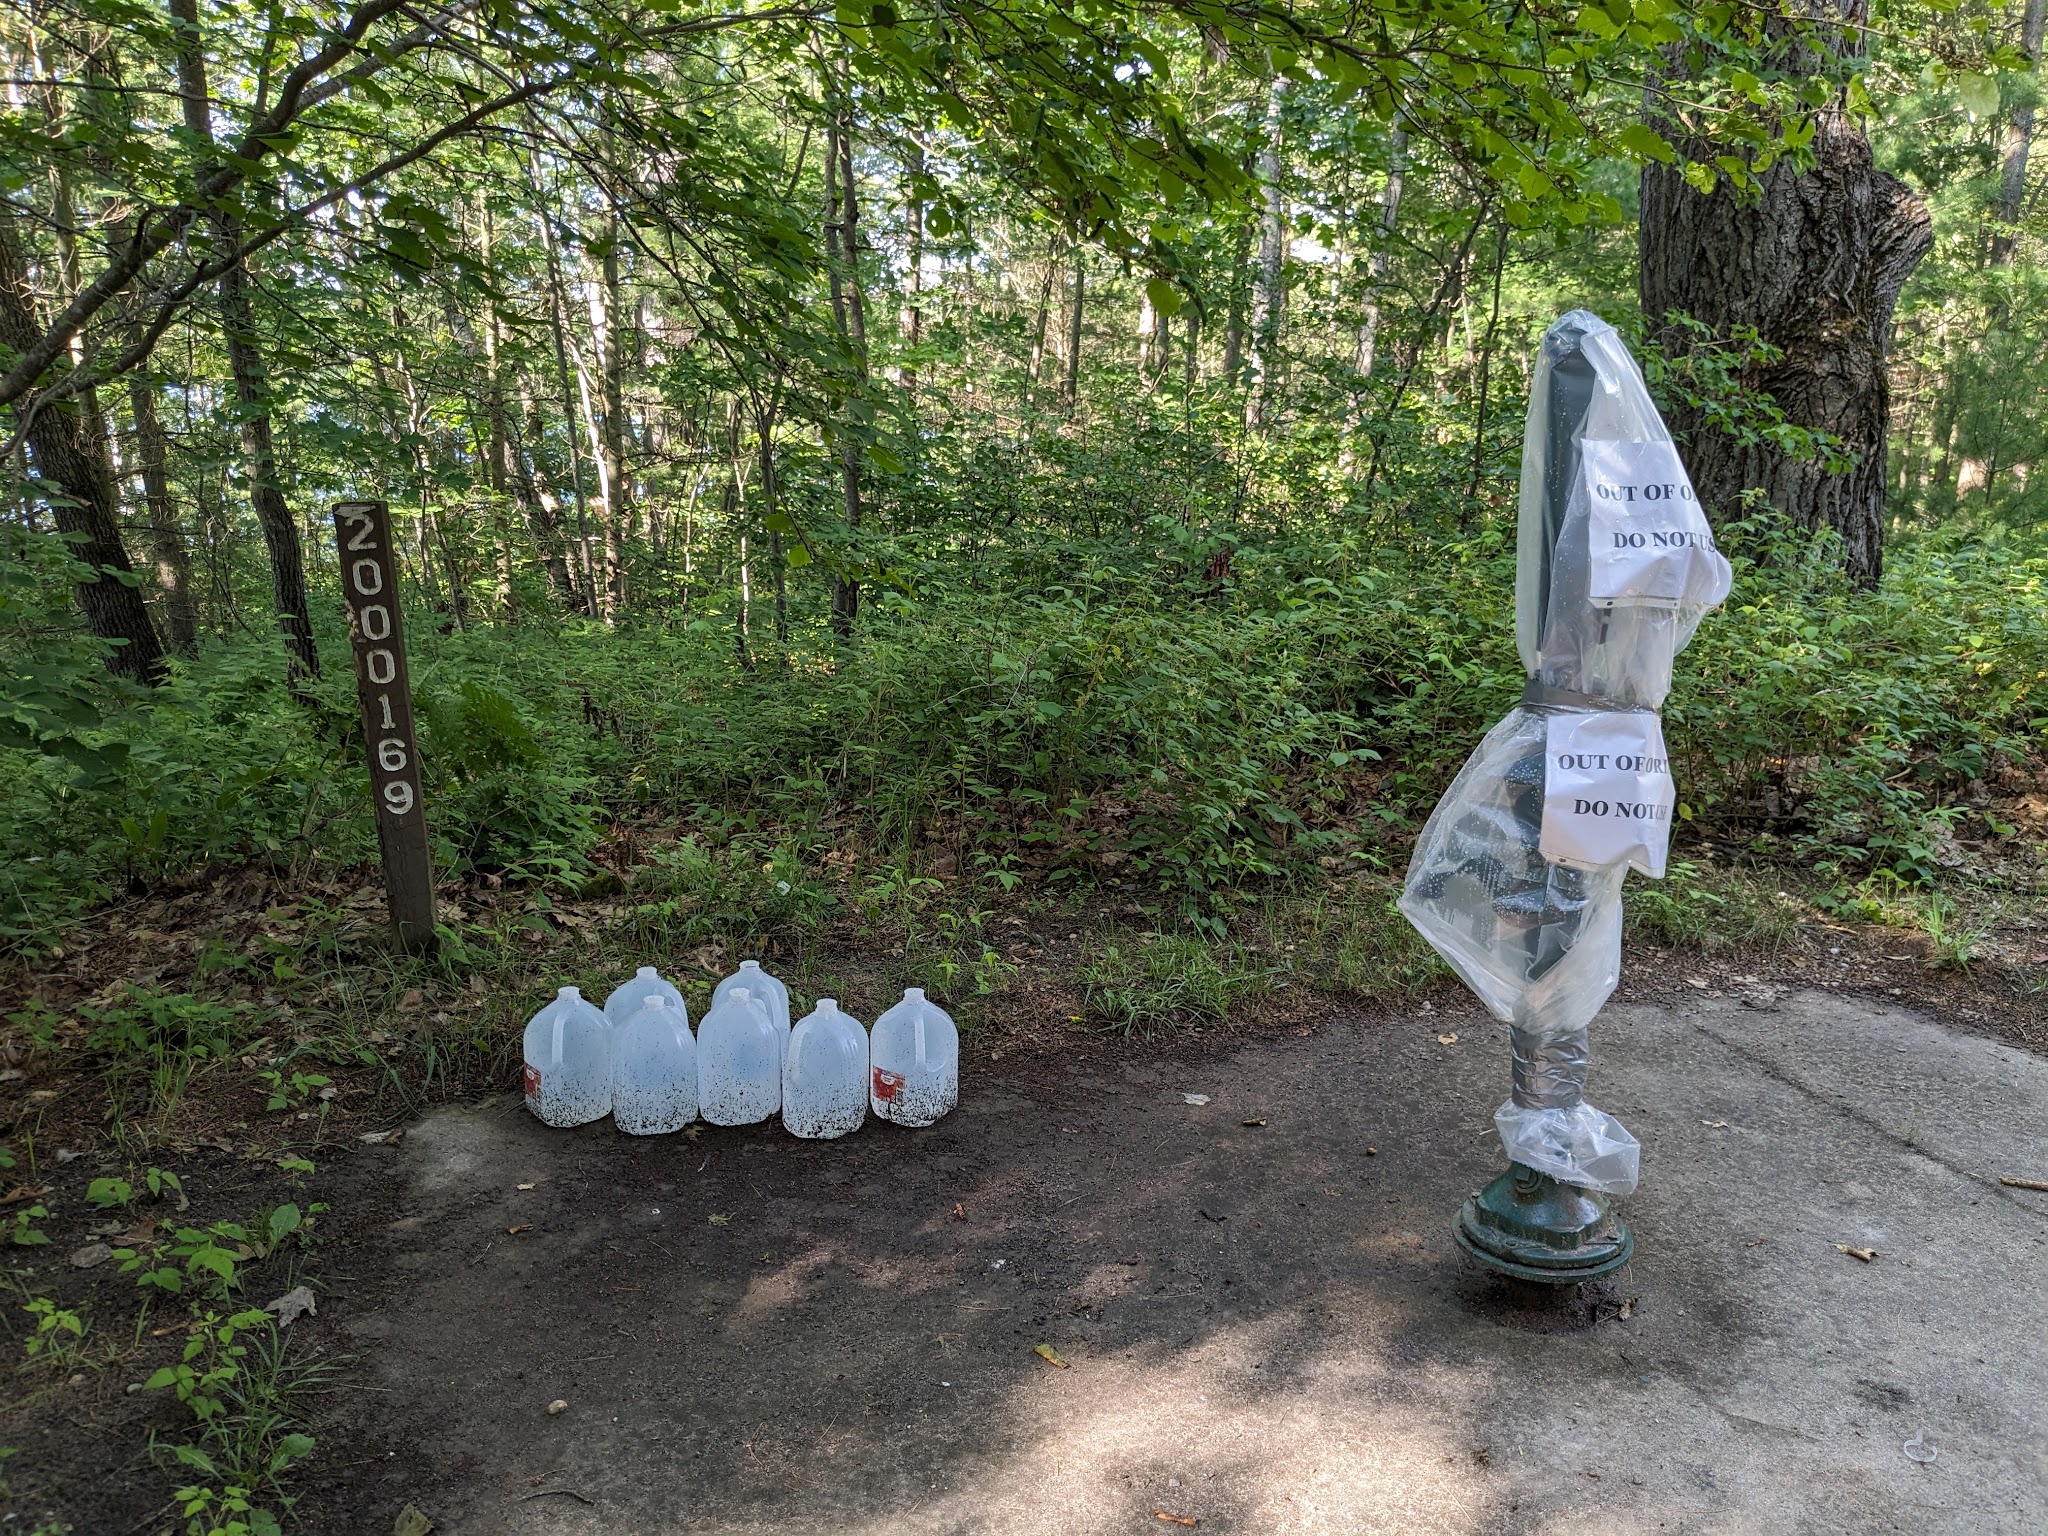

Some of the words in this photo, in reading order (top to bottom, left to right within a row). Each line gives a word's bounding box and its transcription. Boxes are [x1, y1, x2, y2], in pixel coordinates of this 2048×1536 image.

[1596, 483, 1638, 502] OUT
[1643, 484, 1675, 501] OF
[1612, 532, 1646, 549] DO
[1650, 531, 1696, 548] NOT
[344, 512, 414, 816] 2000169
[1557, 754, 1610, 770] OUT
[1615, 755, 1646, 772] OF
[1572, 799, 1609, 817] DO
[1613, 802, 1656, 820] NOT
